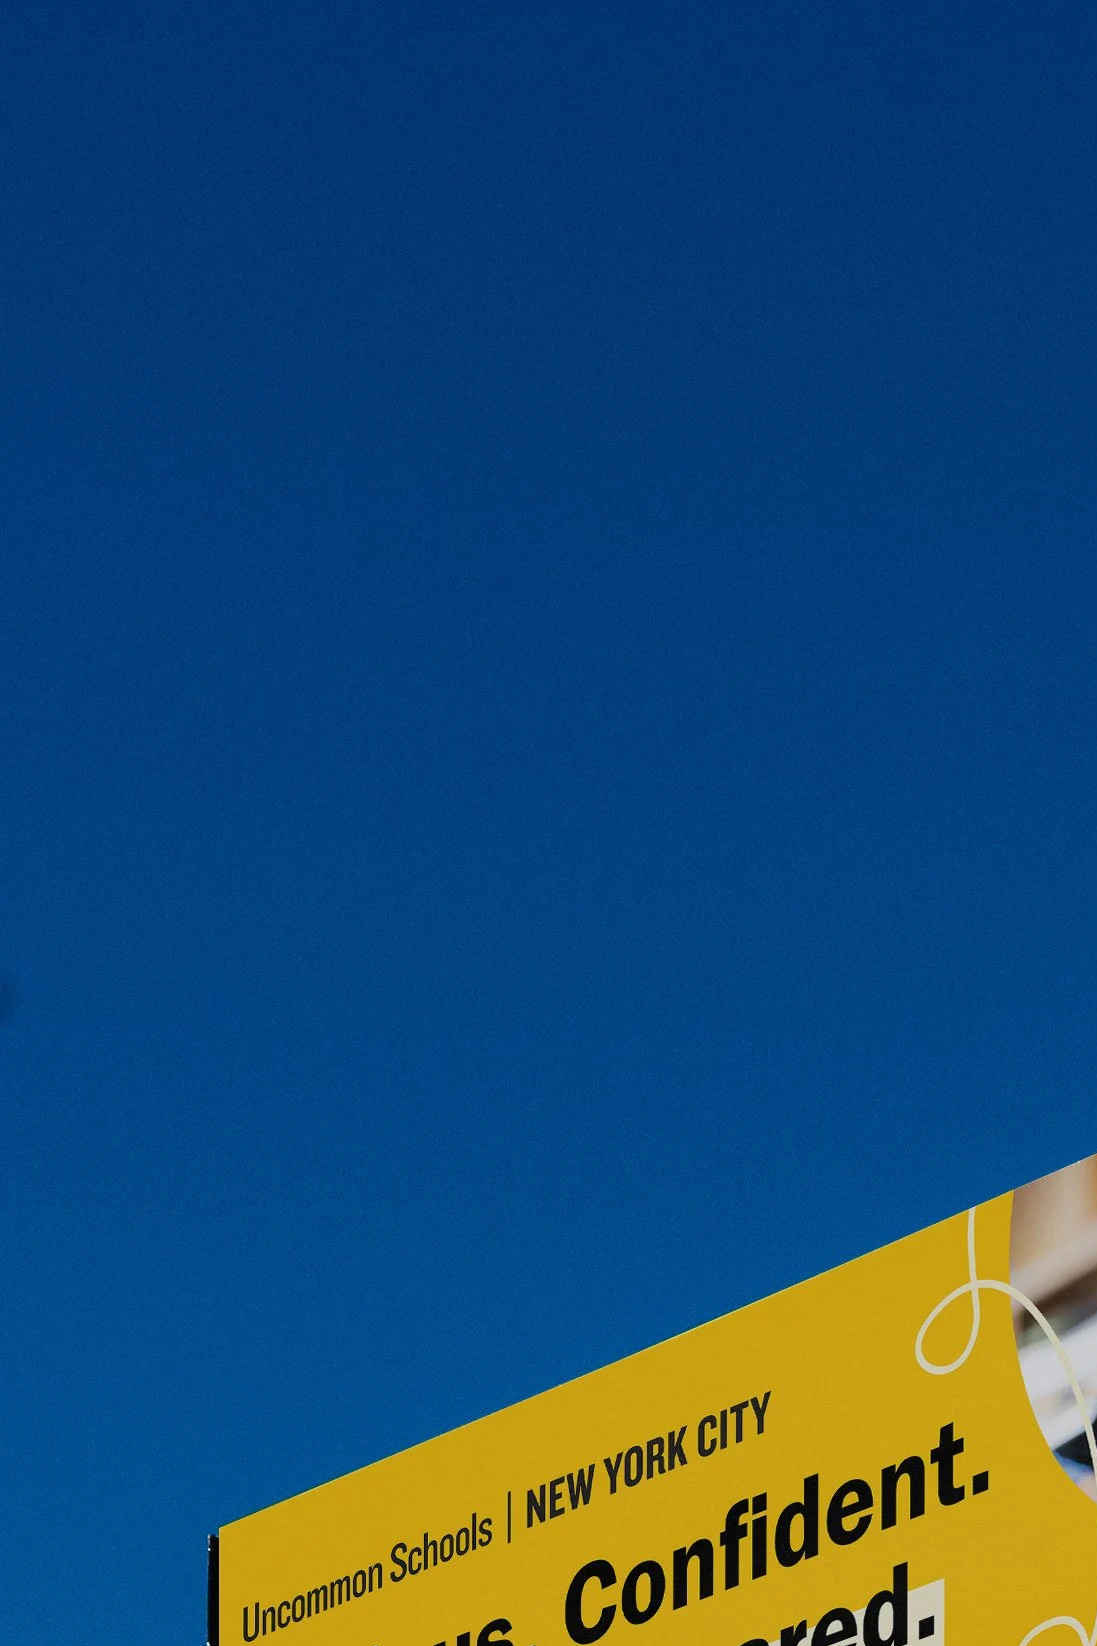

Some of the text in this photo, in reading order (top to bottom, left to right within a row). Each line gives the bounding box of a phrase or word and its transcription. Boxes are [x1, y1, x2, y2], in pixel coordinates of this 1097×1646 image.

[243, 1390, 772, 1643] Uncommon Schools NEW YORK CITY
[564, 1422, 989, 1645] Confident.
